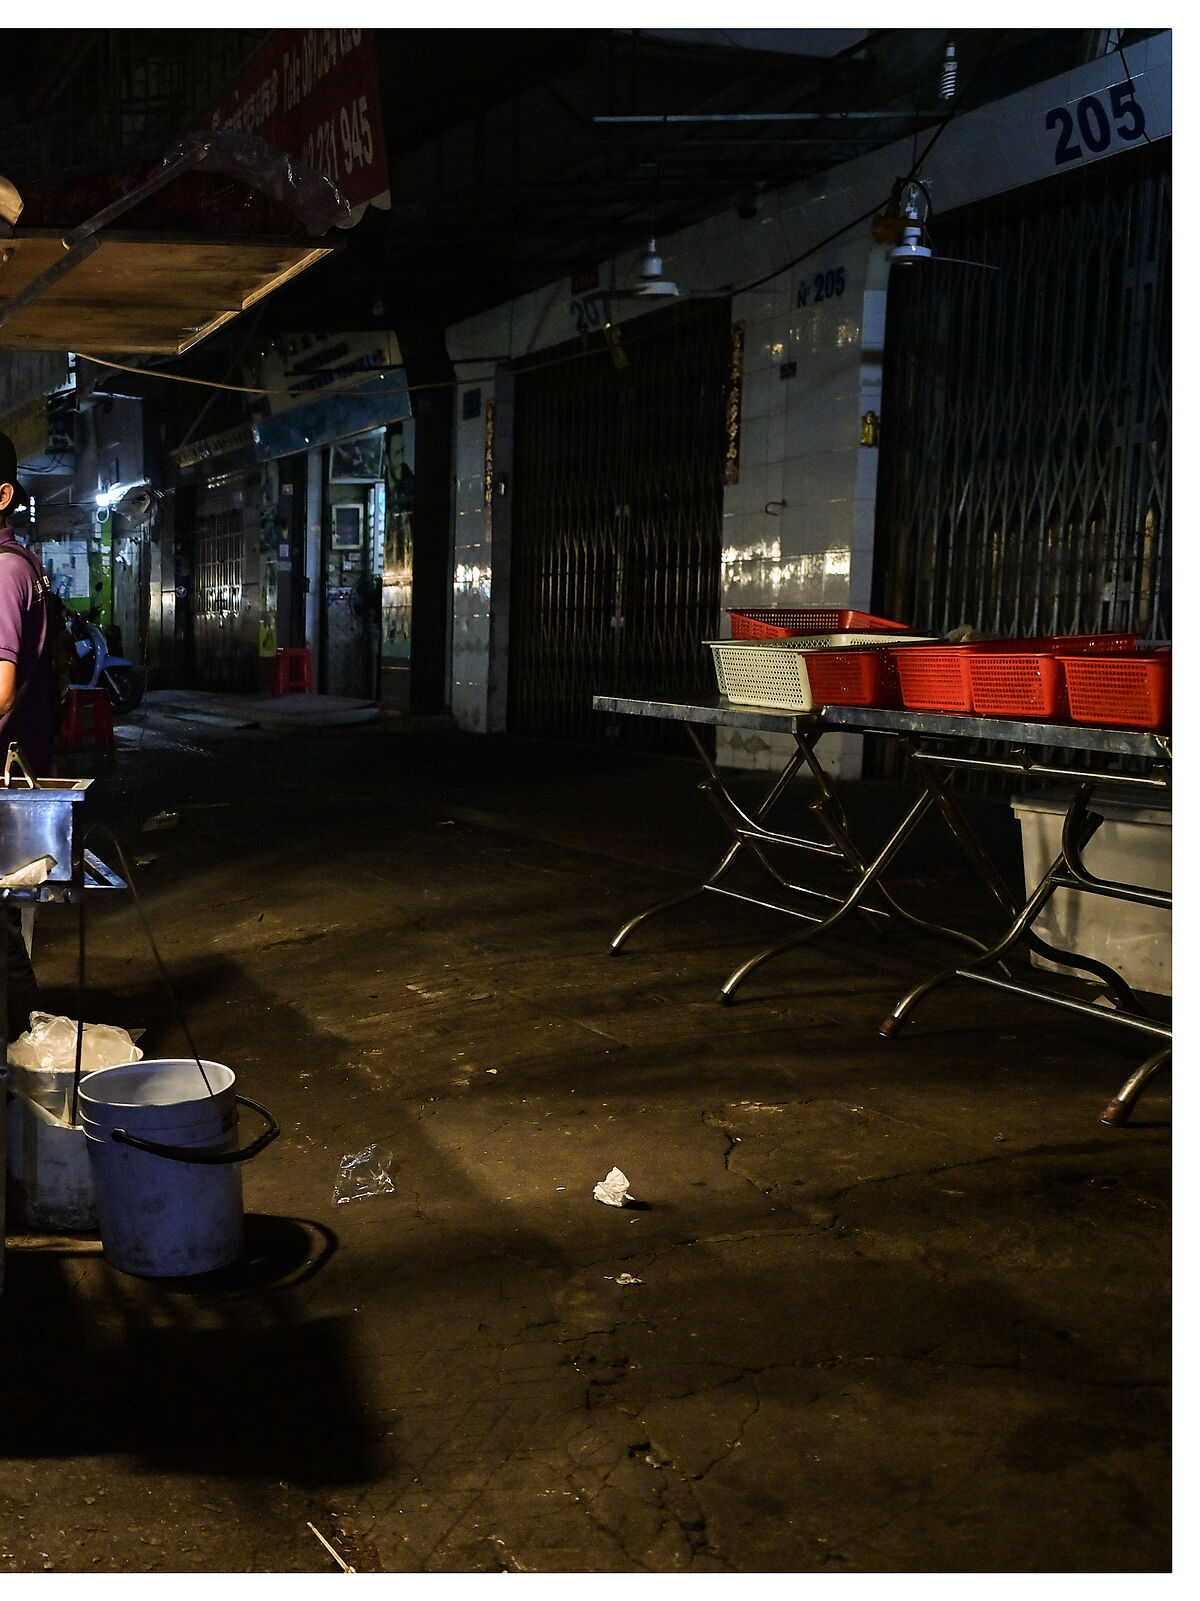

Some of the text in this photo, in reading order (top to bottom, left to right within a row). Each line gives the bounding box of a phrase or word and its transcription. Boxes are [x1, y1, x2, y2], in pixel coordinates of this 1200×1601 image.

[340, 94, 374, 175] 945
[1045, 80, 1146, 166] 205
[814, 266, 846, 303] 205
